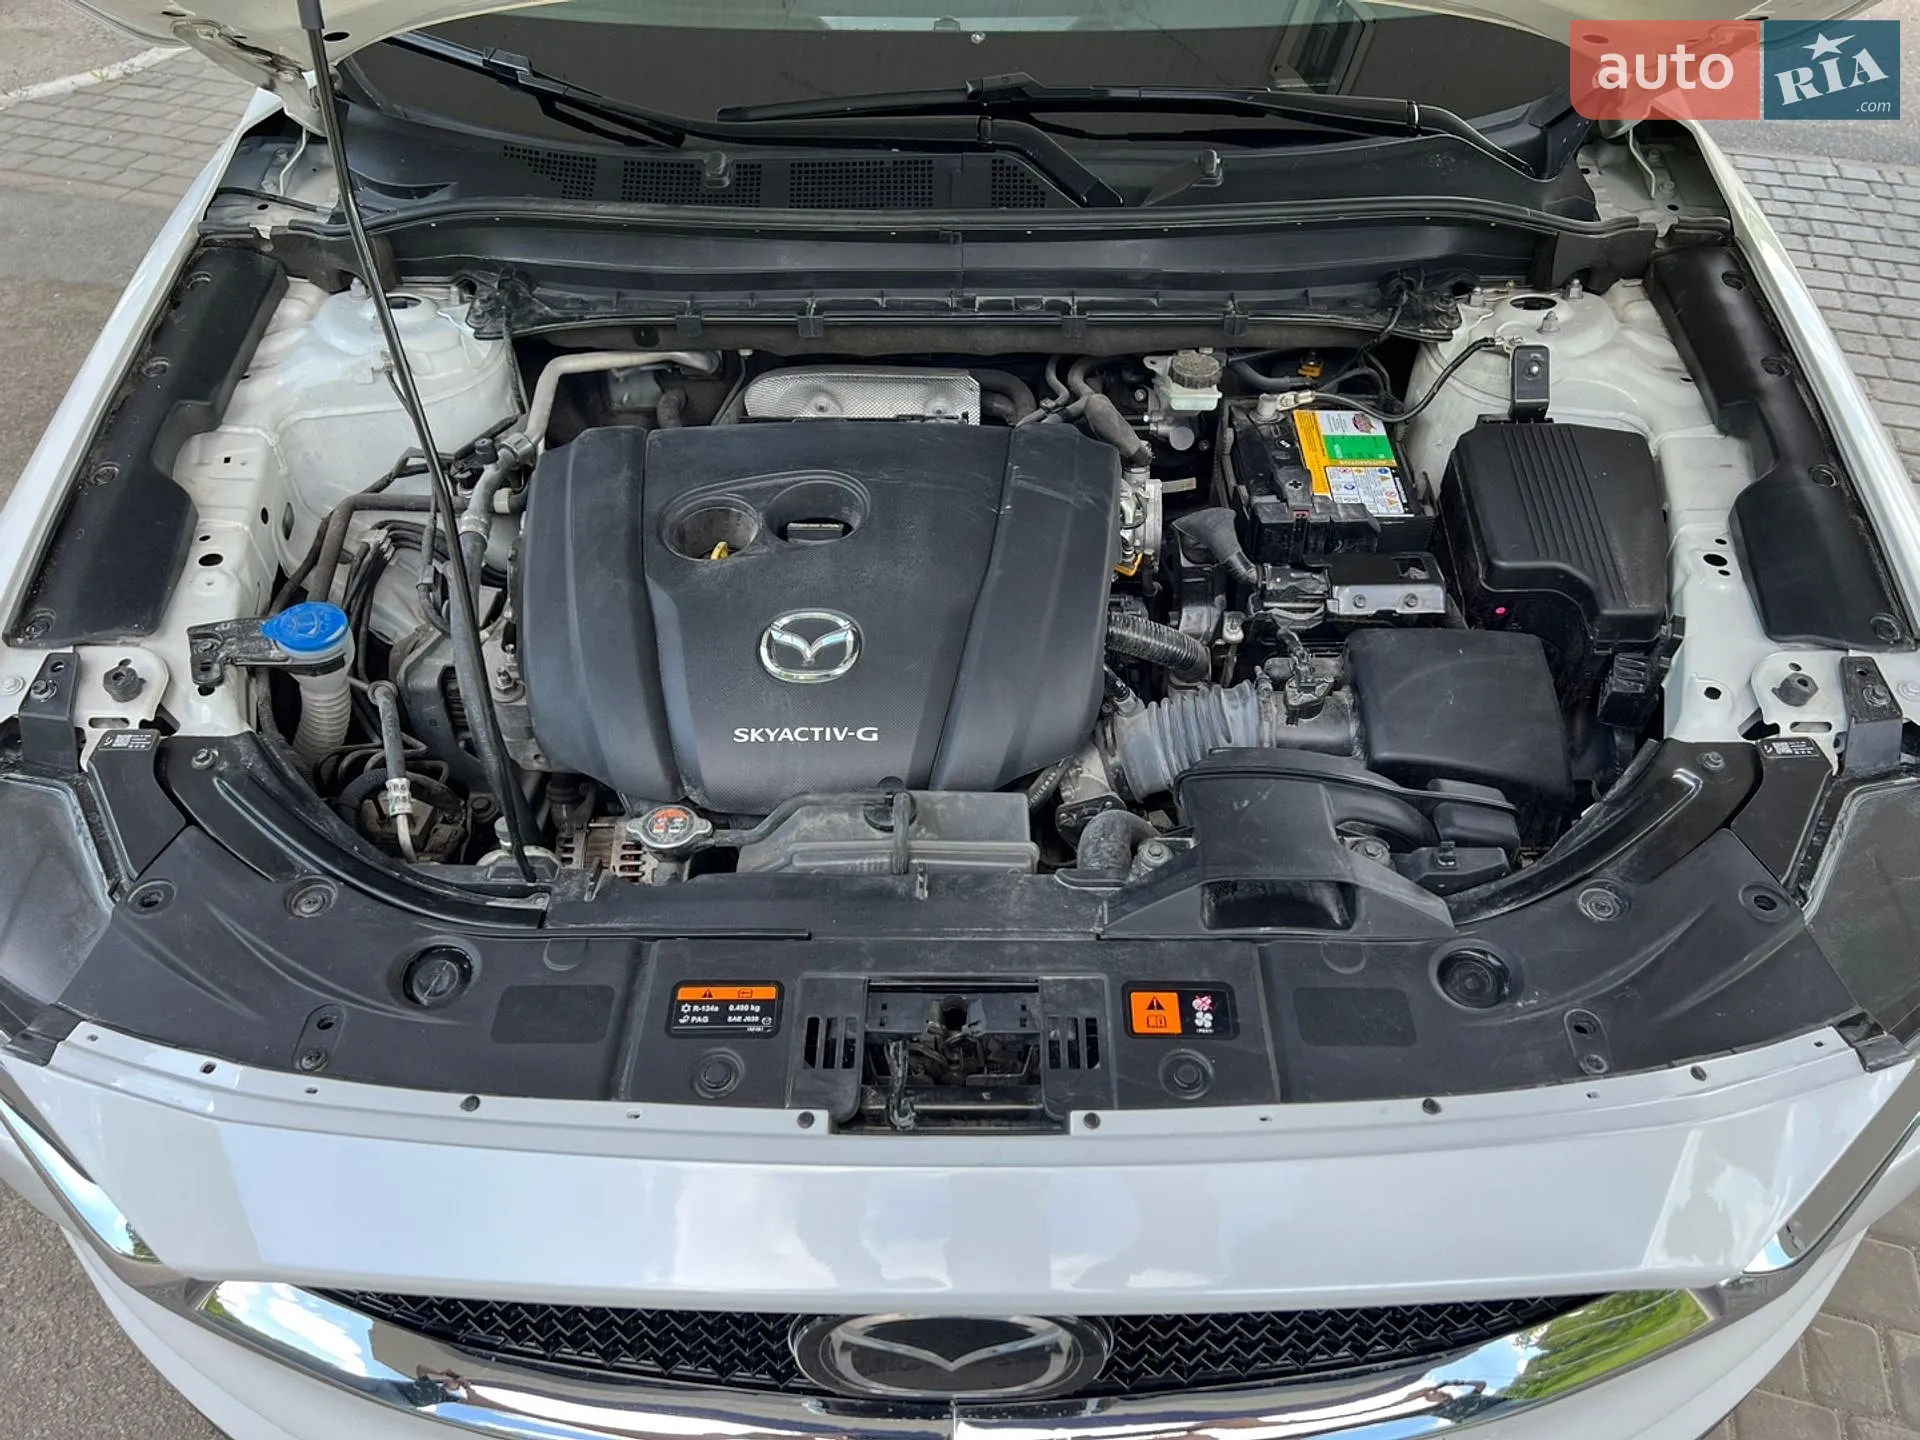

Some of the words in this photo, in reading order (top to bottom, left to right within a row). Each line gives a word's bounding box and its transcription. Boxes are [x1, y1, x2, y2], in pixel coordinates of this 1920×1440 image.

[733, 726, 879, 743] SKYACTIV-G
[750, 1004, 760, 1013] kg
[690, 1015, 709, 1023] PAG
